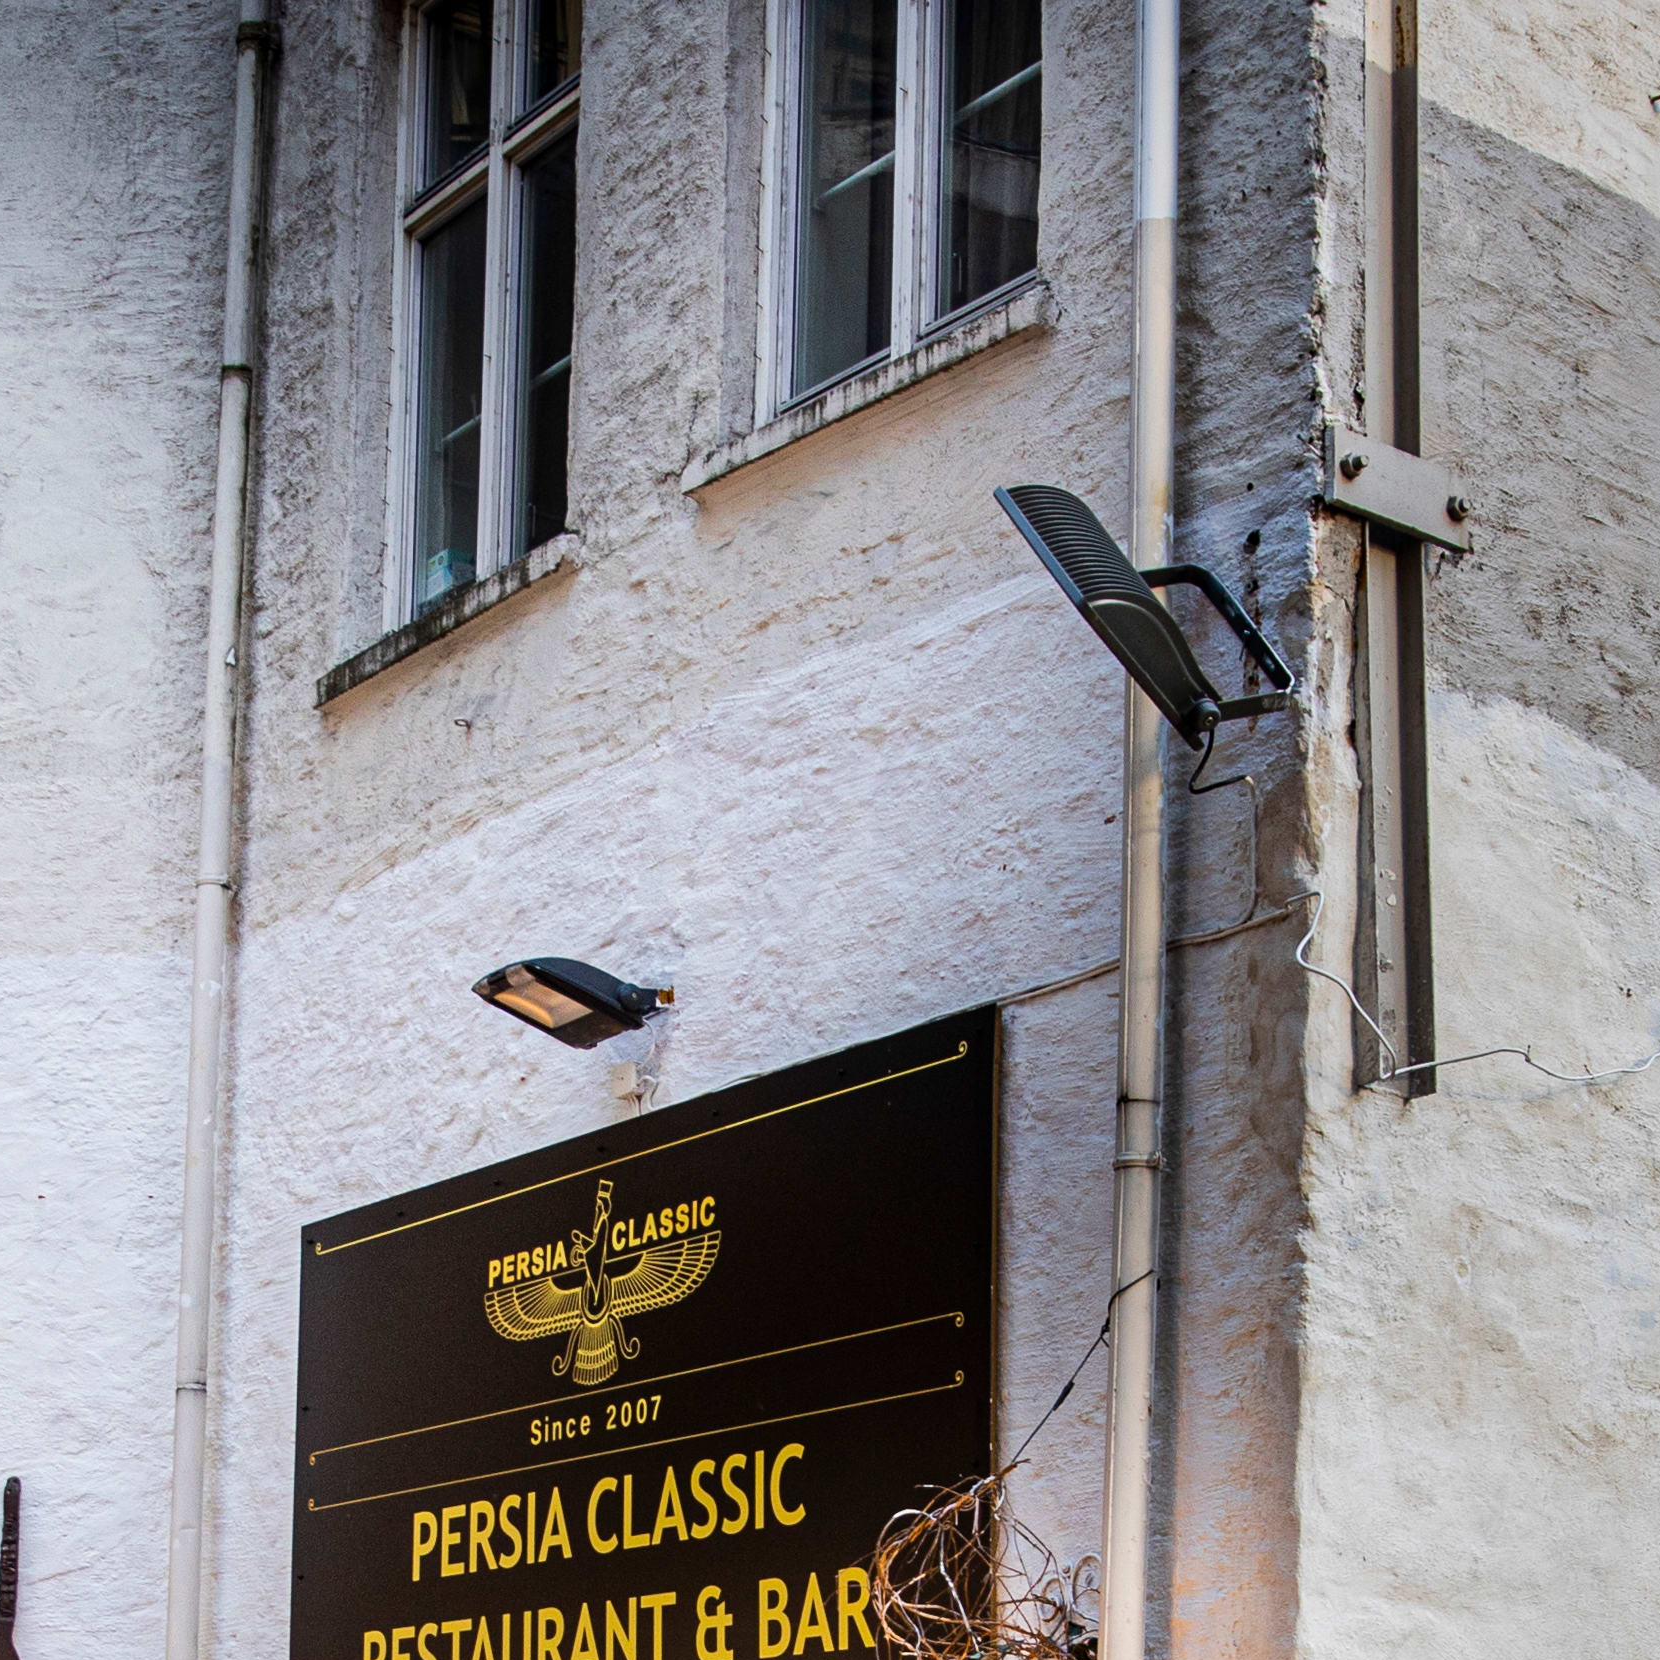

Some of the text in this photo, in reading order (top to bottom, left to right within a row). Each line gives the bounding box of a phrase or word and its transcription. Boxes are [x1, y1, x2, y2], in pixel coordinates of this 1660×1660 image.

[488, 1196, 716, 1288] PERSIA CLASSIC
[530, 1395, 662, 1446] Since 2007
[412, 1443, 806, 1582] PERSIA CLASSIC
[758, 1567, 876, 1660] BAR
